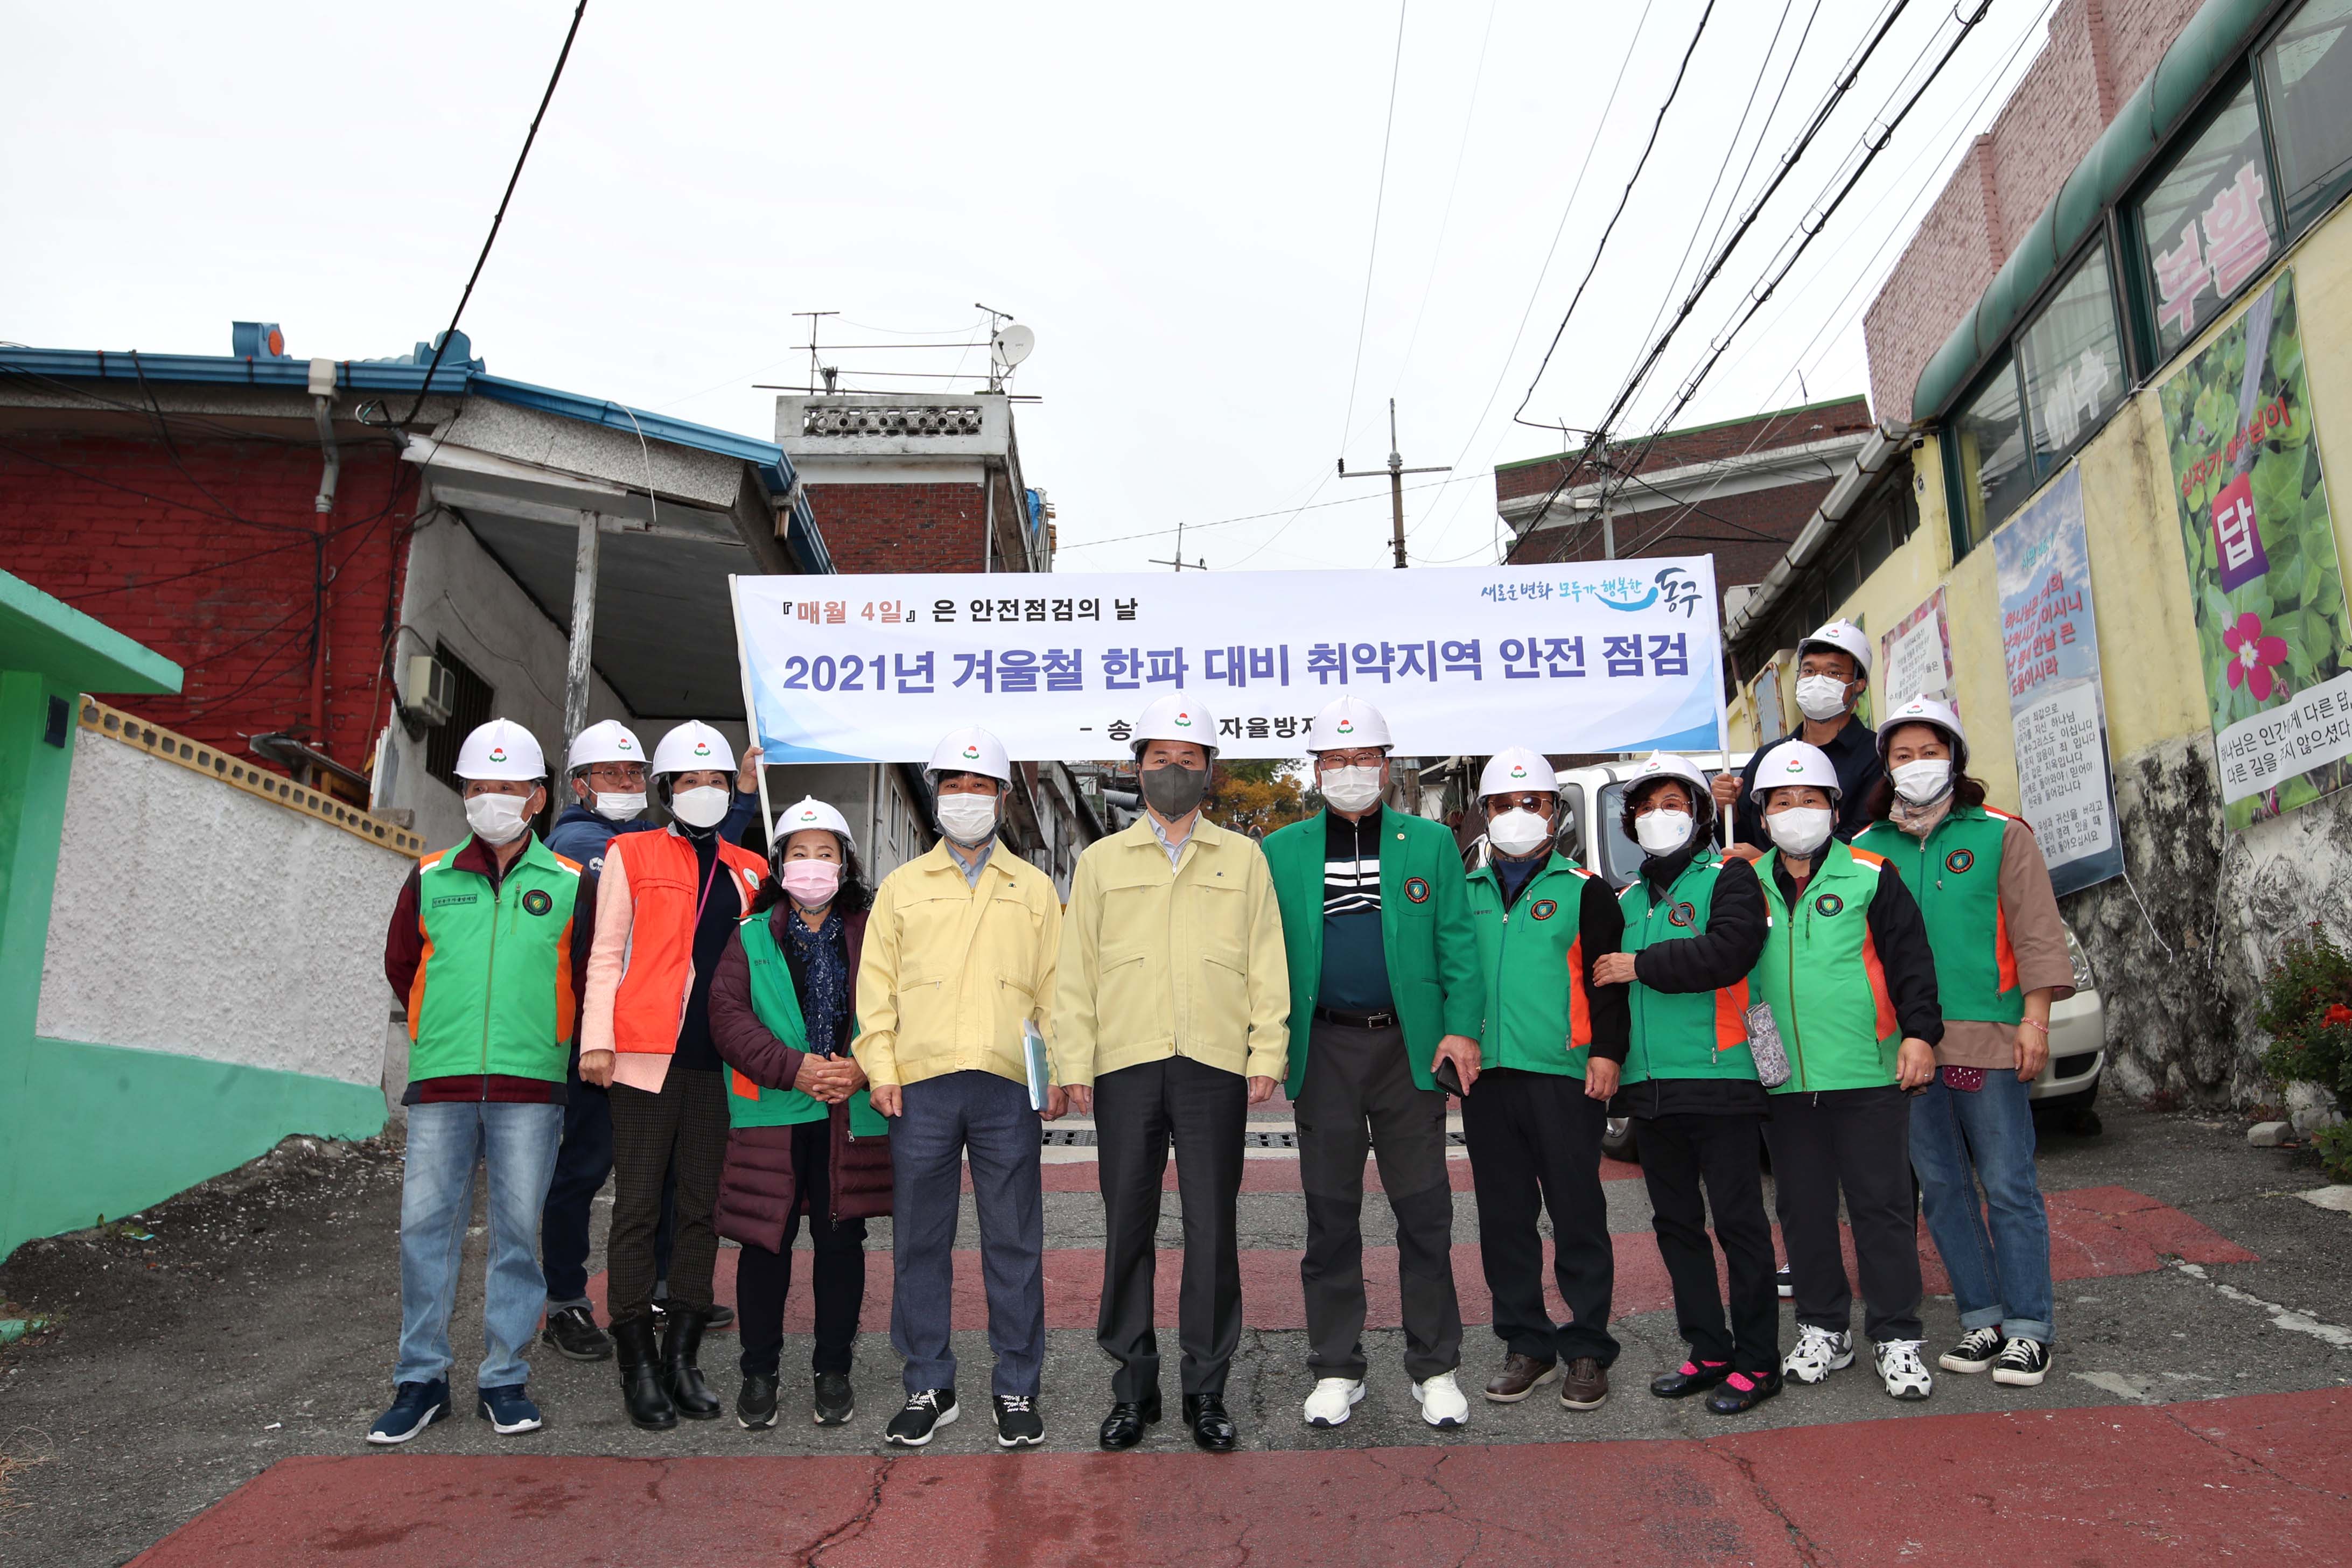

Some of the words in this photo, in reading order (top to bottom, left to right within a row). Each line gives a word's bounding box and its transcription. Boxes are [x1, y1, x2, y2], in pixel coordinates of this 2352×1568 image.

[2153, 159, 2271, 336] 부활
[2181, 448, 2222, 498] 십자가
[2226, 396, 2292, 463] 예수님이
[2217, 496, 2254, 571] 답
[1481, 583, 1518, 603] 새로운
[1520, 581, 1553, 600] 변화
[1559, 581, 1597, 603] 모두가
[1600, 577, 1642, 601] 행복한
[1655, 567, 1703, 619] 동구
[932, 599, 957, 622] 은
[970, 598, 1100, 622] 안전점검의
[1114, 597, 1139, 621] 날
[2037, 591, 2082, 631] 이시니
[2033, 629, 2056, 657] 만날
[2060, 621, 2075, 645] 큰
[783, 650, 934, 694] 2021년
[951, 648, 1083, 694] 겨울철
[1101, 647, 1189, 690] 한파
[1205, 644, 1289, 688] 대비
[1307, 639, 1482, 685] 취약지역
[1499, 635, 1586, 679] 안전
[1602, 632, 1689, 677] 점검
[2012, 655, 2058, 697] 도움이시라
[2035, 722, 2047, 734] 지신
[2051, 711, 2075, 727] 하나님
[2061, 719, 2092, 738] 이십니다
[2221, 733, 2257, 762] 하나님은
[2304, 697, 2334, 722] 다른
[2060, 741, 2068, 752] 죄
[2074, 732, 2096, 749] 입니다
[2227, 763, 2248, 785] 다른
[2249, 753, 2277, 777] 길을
[2297, 718, 2351, 755] 않으셨다
[2045, 751, 2083, 772] 지옥입니다
[2045, 780, 2081, 801] 들어갑니다
[2056, 809, 2078, 825] 귀신을
[2083, 800, 2103, 815] 버리고
[2056, 825, 2070, 839] 열려
[2092, 815, 2102, 826] 때
